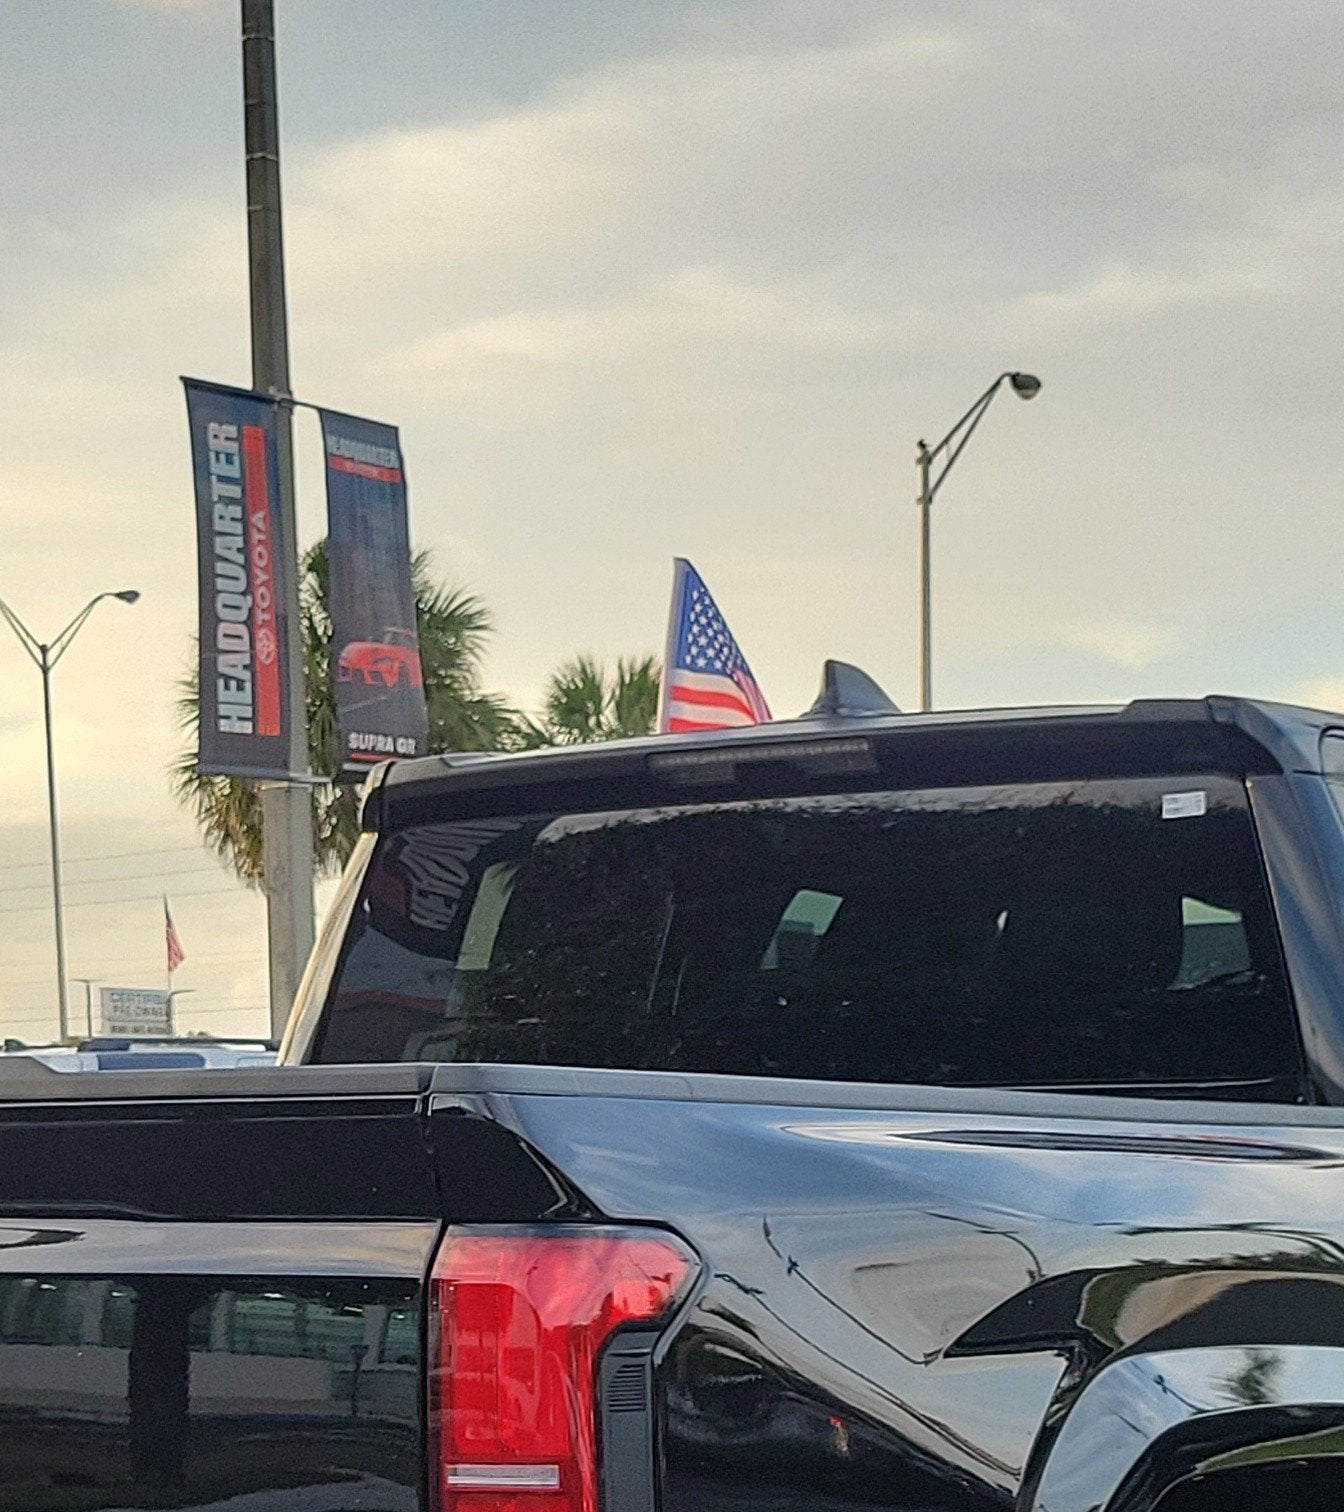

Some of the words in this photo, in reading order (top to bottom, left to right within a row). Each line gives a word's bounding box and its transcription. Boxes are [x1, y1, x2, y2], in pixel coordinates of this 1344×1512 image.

[208, 422, 254, 735] HEADQUARTER
[251, 510, 272, 622] TOYOTA
[349, 732, 394, 752] SUPRA
[396, 737, 416, 754] GR
